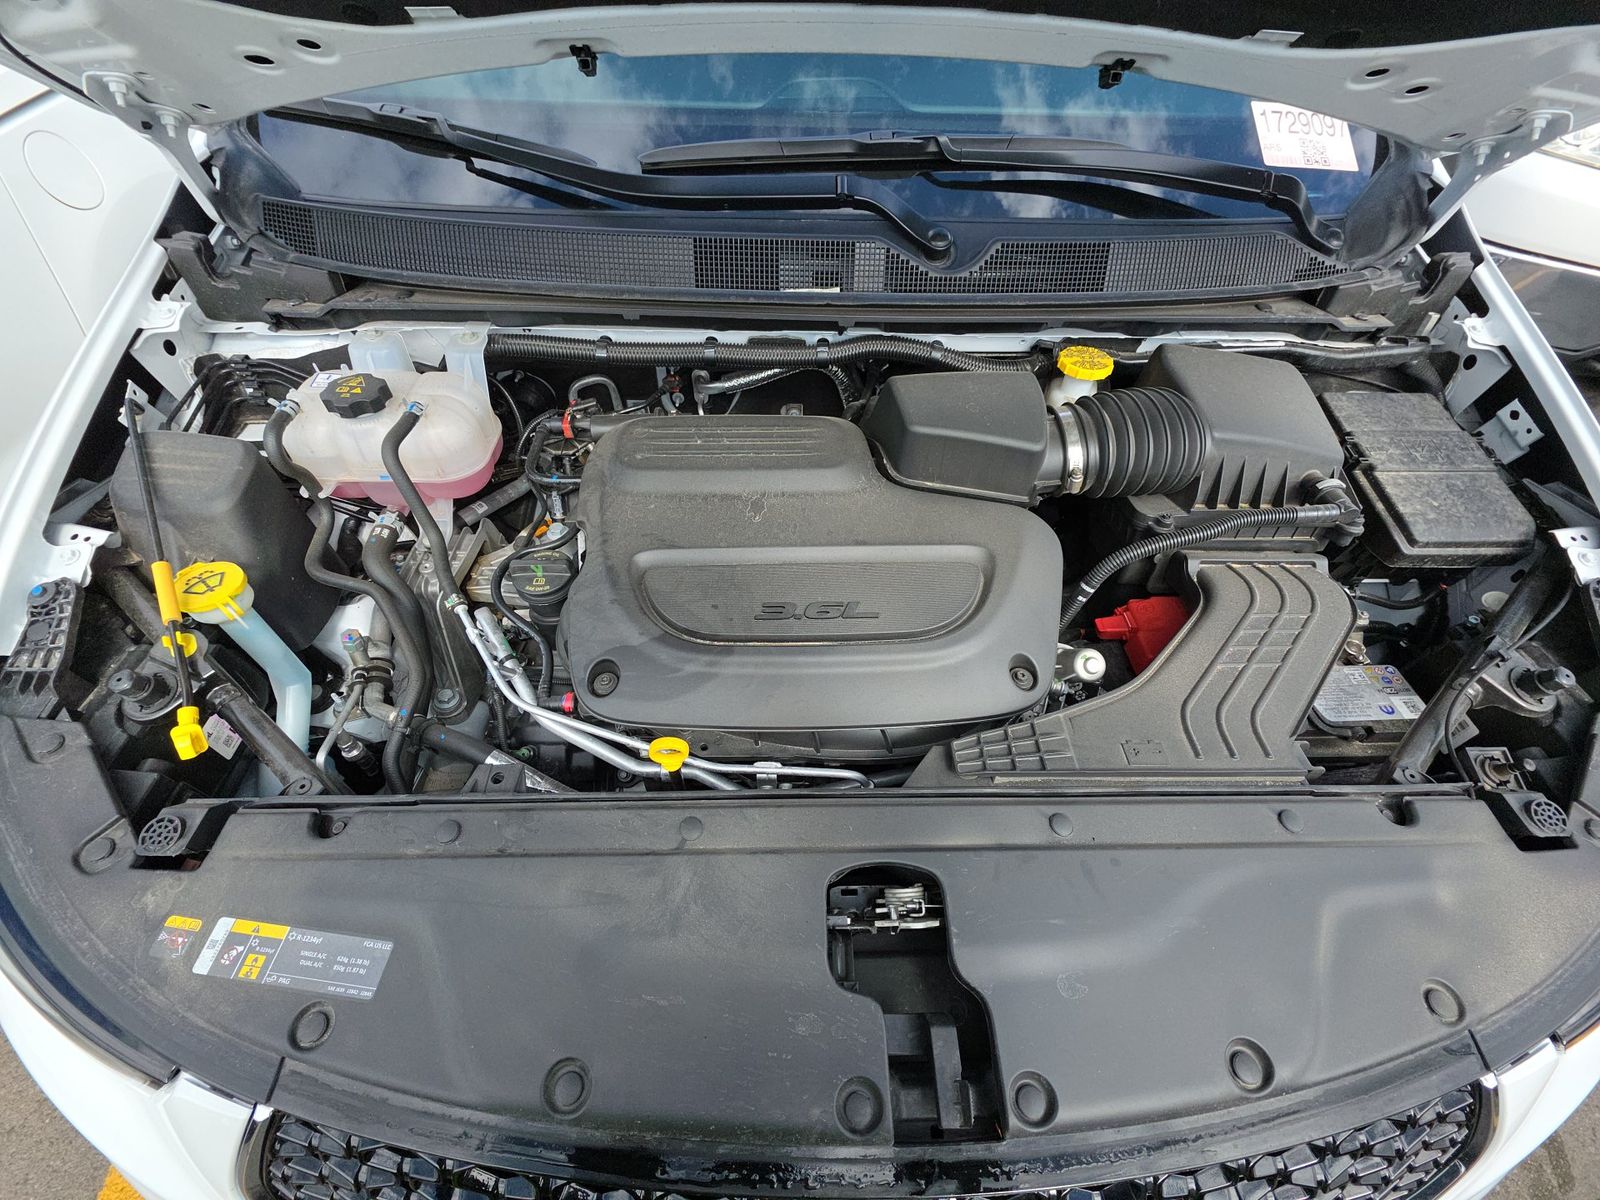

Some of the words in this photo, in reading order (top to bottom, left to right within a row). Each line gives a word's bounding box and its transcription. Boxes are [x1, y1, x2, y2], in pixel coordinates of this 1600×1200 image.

[753, 601, 880, 621] 3.6L
[295, 934, 324, 945] R-1234yf
[363, 940, 374, 948] FCA
[300, 950, 318, 958] SINGLE
[317, 952, 328, 960] A/C
[299, 959, 314, 967] DUAL
[313, 960, 324, 968] A/C
[277, 976, 291, 985] PAG
